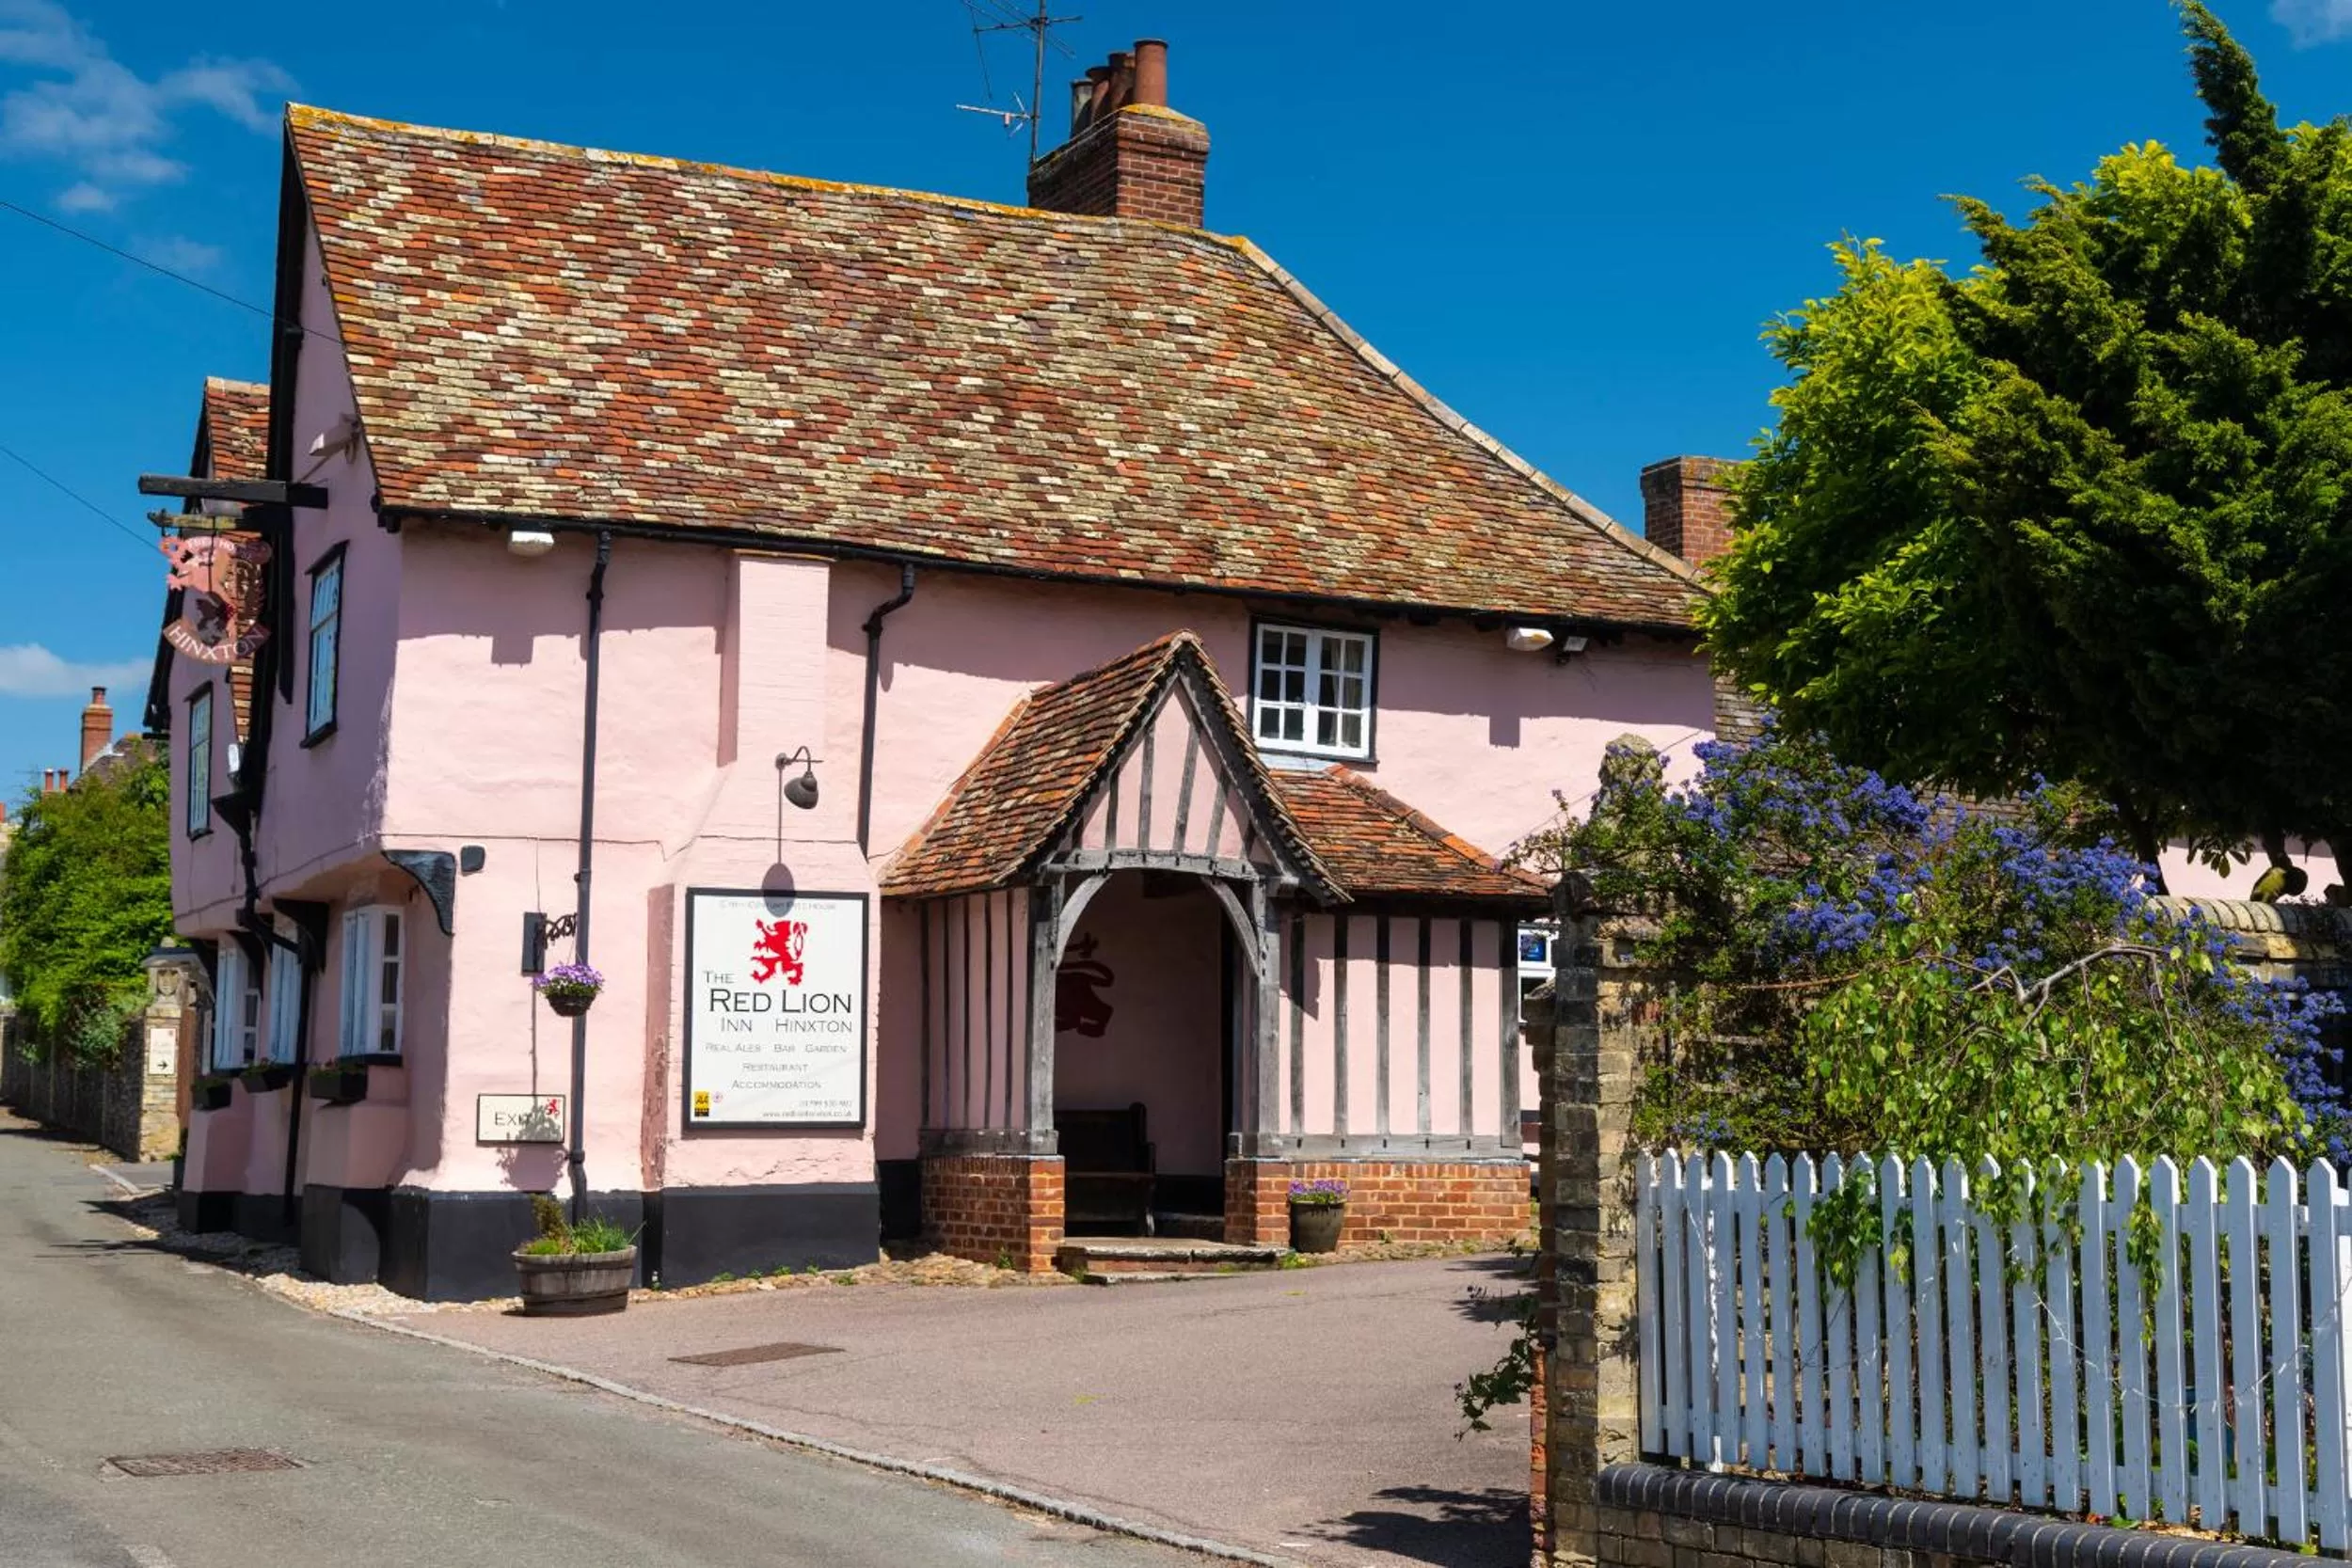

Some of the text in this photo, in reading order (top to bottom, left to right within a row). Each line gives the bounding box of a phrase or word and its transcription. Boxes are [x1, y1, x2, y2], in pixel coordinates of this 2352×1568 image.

[168, 626, 265, 660] HINXTON
[703, 971, 735, 984] THE
[709, 989, 851, 1013] RED LION
[721, 1017, 852, 1033] INN HINXTON
[495, 1112, 532, 1127] EXIT
